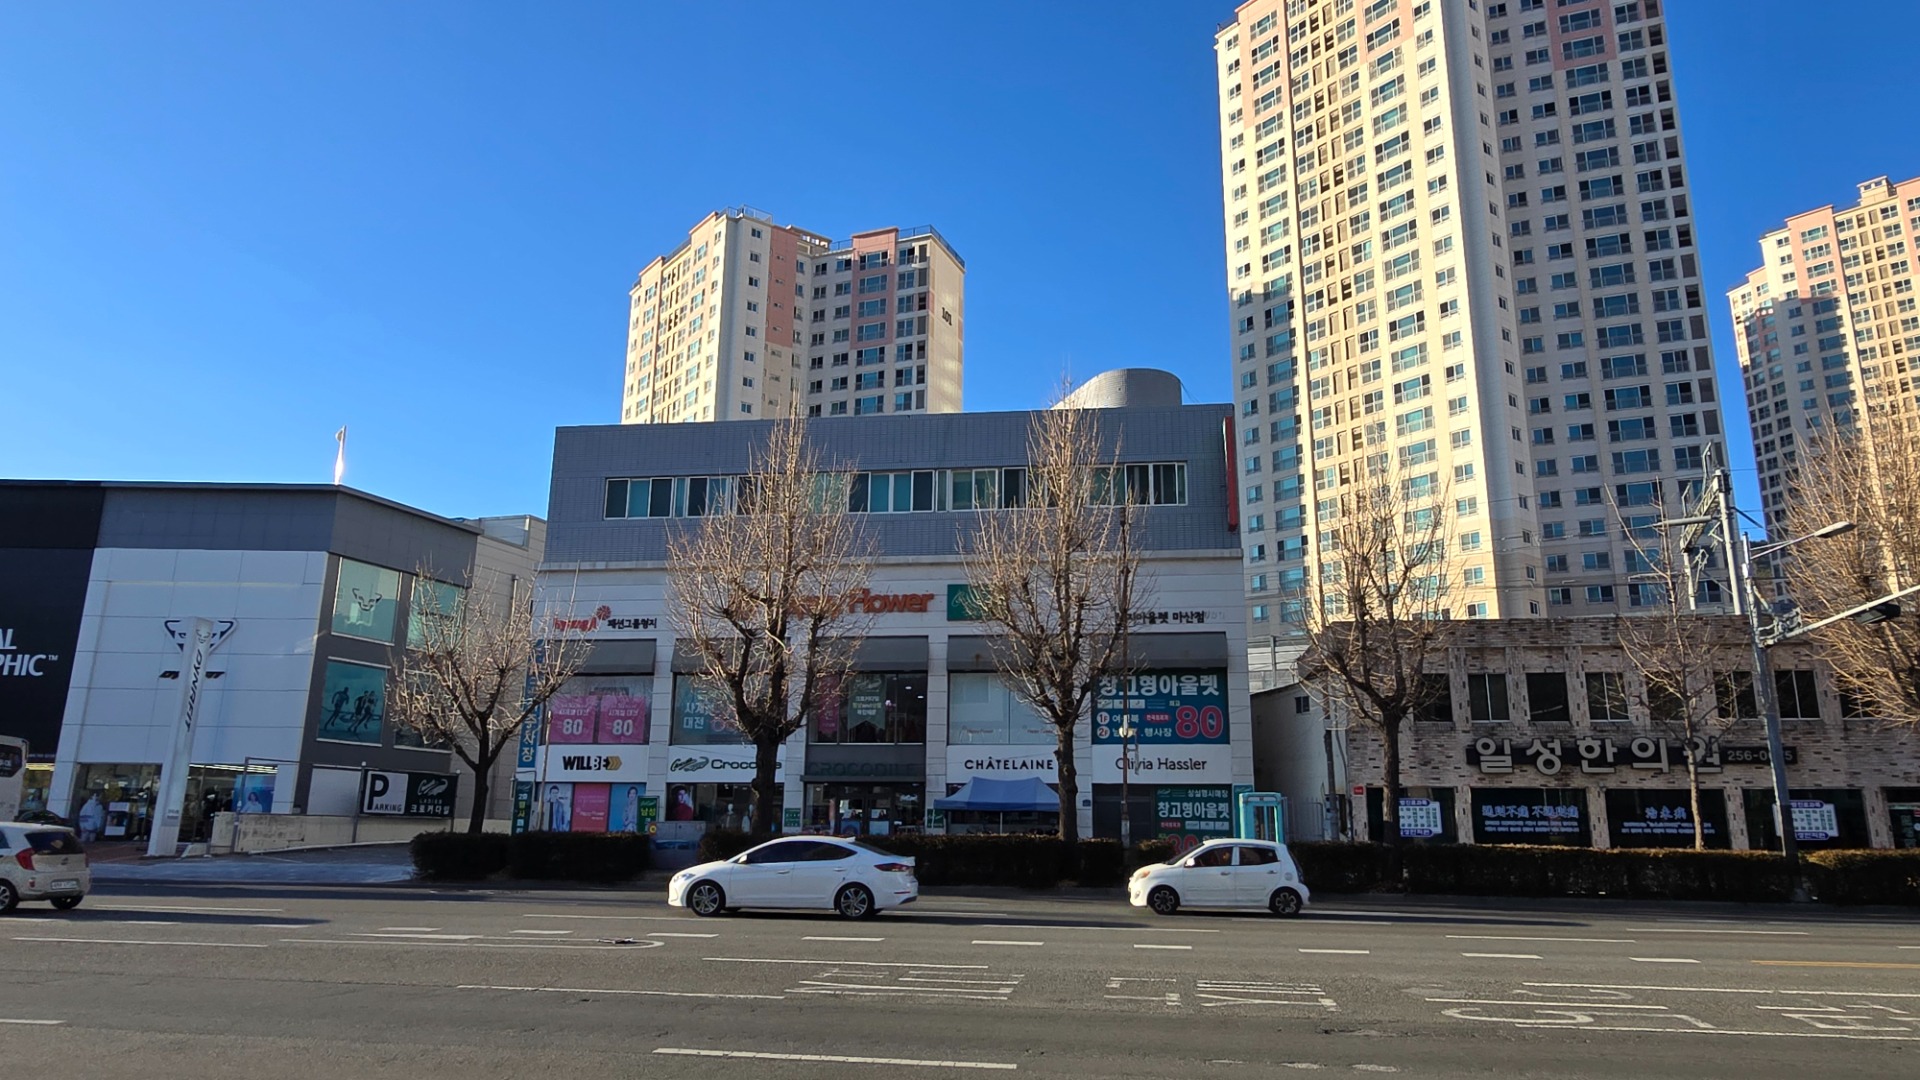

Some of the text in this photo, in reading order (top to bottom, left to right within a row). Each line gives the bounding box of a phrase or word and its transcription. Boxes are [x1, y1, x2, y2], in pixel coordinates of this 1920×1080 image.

[1116, 611, 1168, 624] 지아울렛
[1112, 714, 1139, 723] 여복
[1175, 705, 1223, 739] 80
[563, 719, 583, 735] 80
[612, 719, 633, 736] 80
[1476, 736, 1793, 775] 일성한의원 256-05
[711, 759, 782, 769] Crocoe
[1158, 758, 1207, 770] Hassler
[1158, 802, 1230, 818] 창고형아울렛
